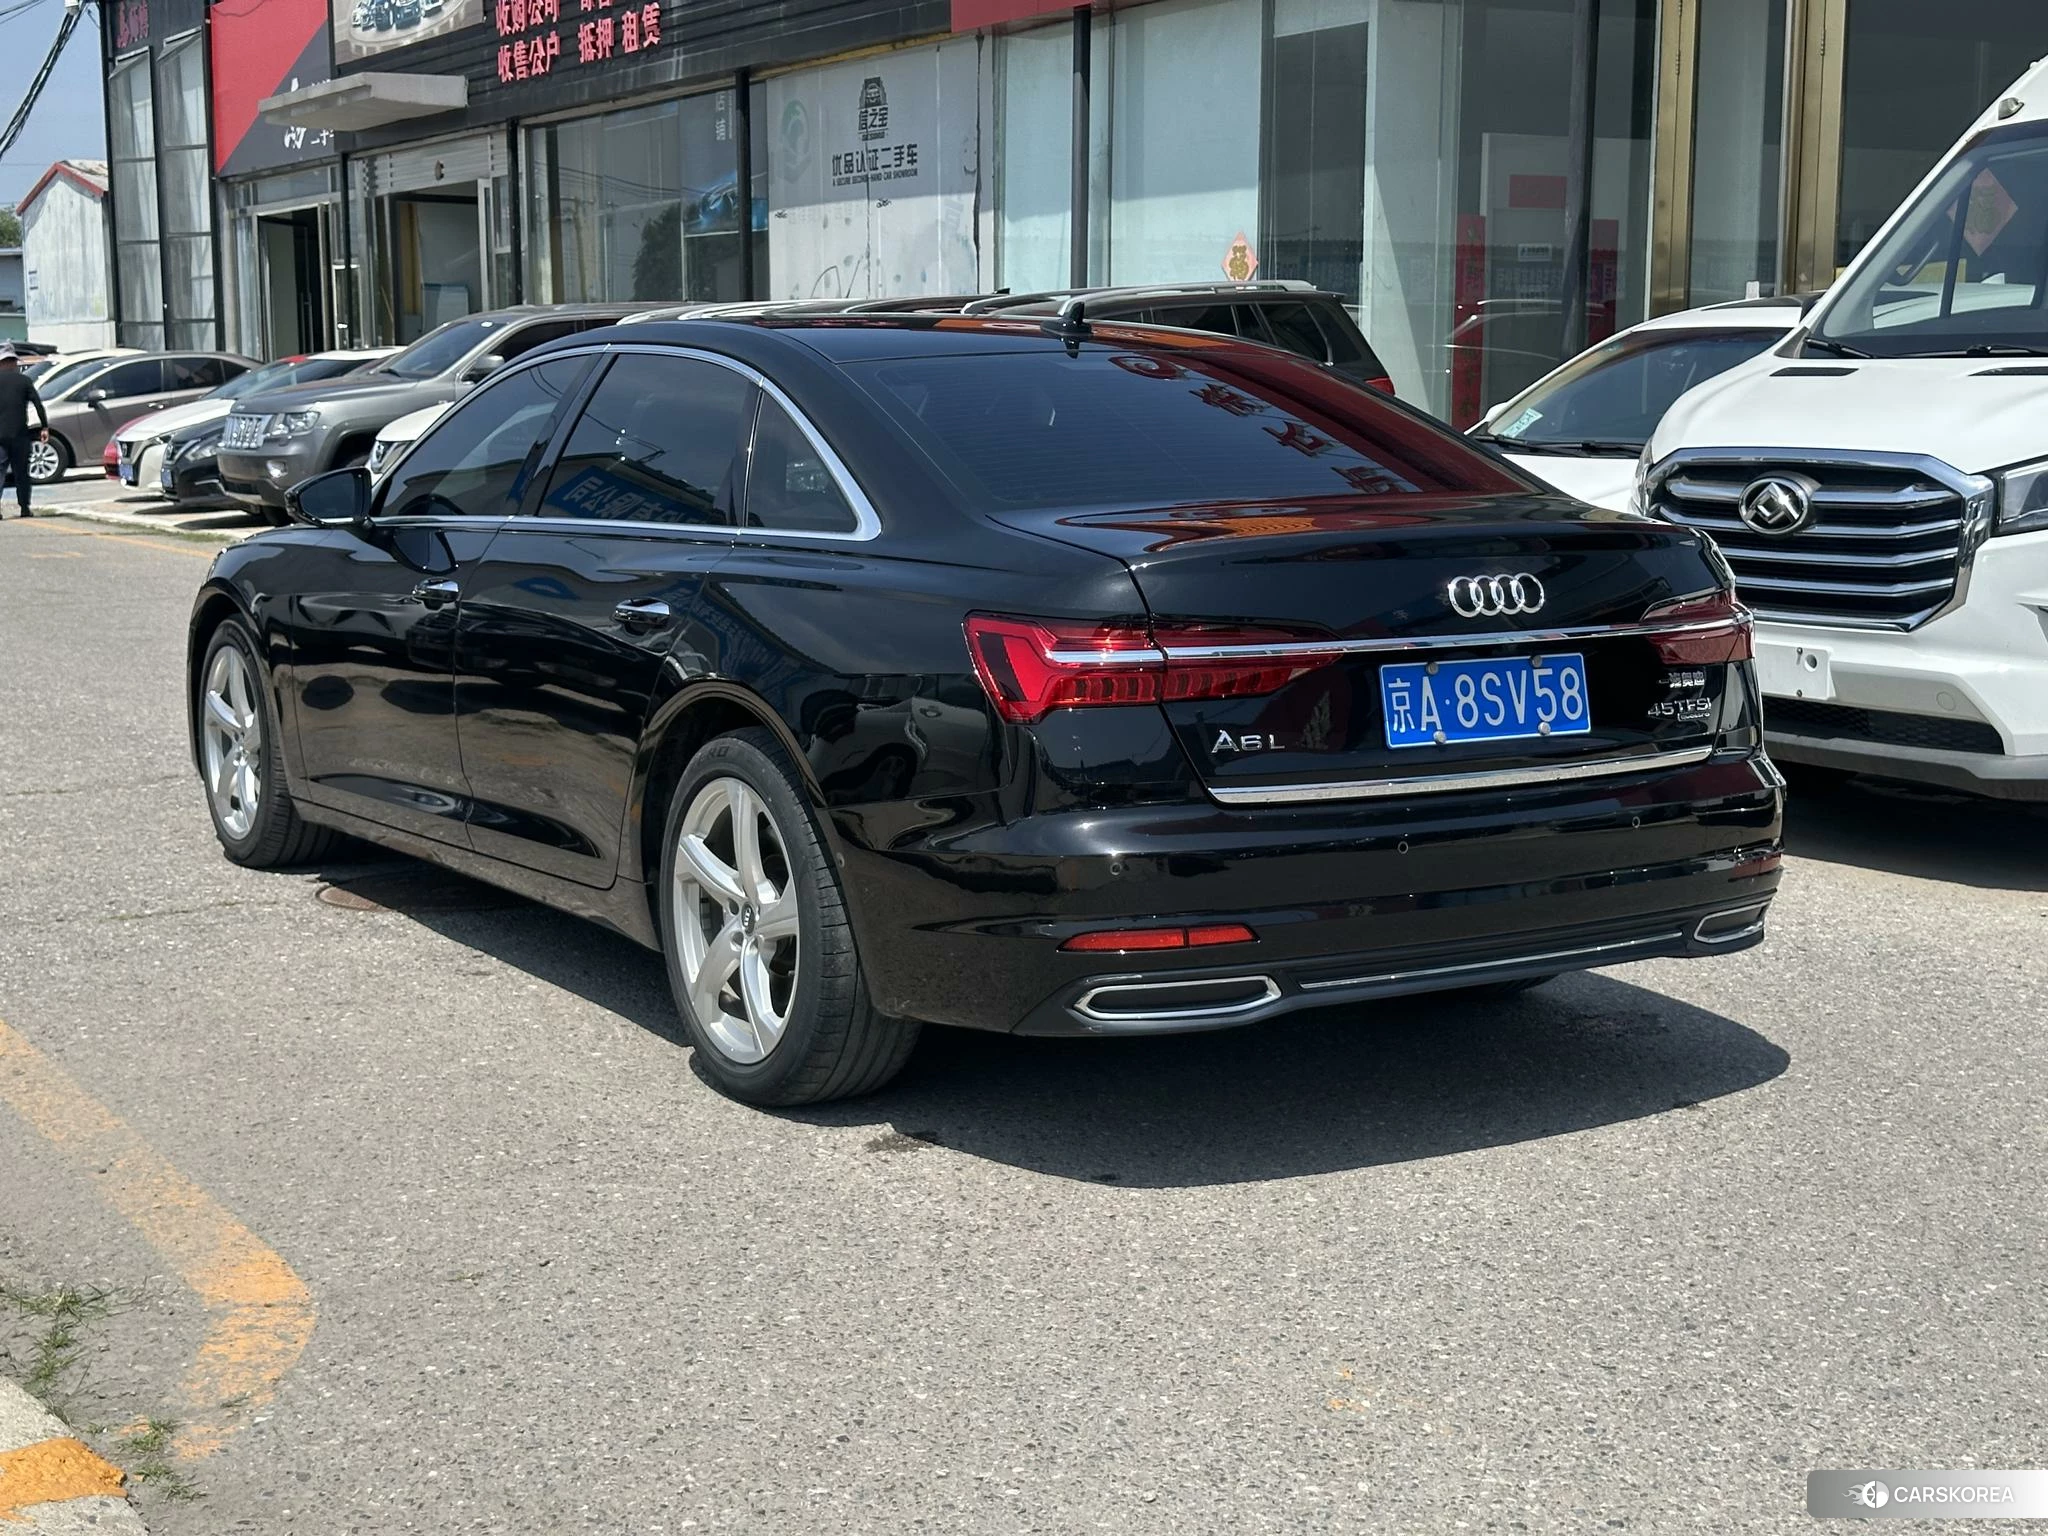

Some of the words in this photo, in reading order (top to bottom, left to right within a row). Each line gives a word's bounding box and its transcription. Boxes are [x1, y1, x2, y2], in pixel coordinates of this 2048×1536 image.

[498, 31, 561, 83] 收售公户
[832, 143, 918, 176] 优品认证二手车
